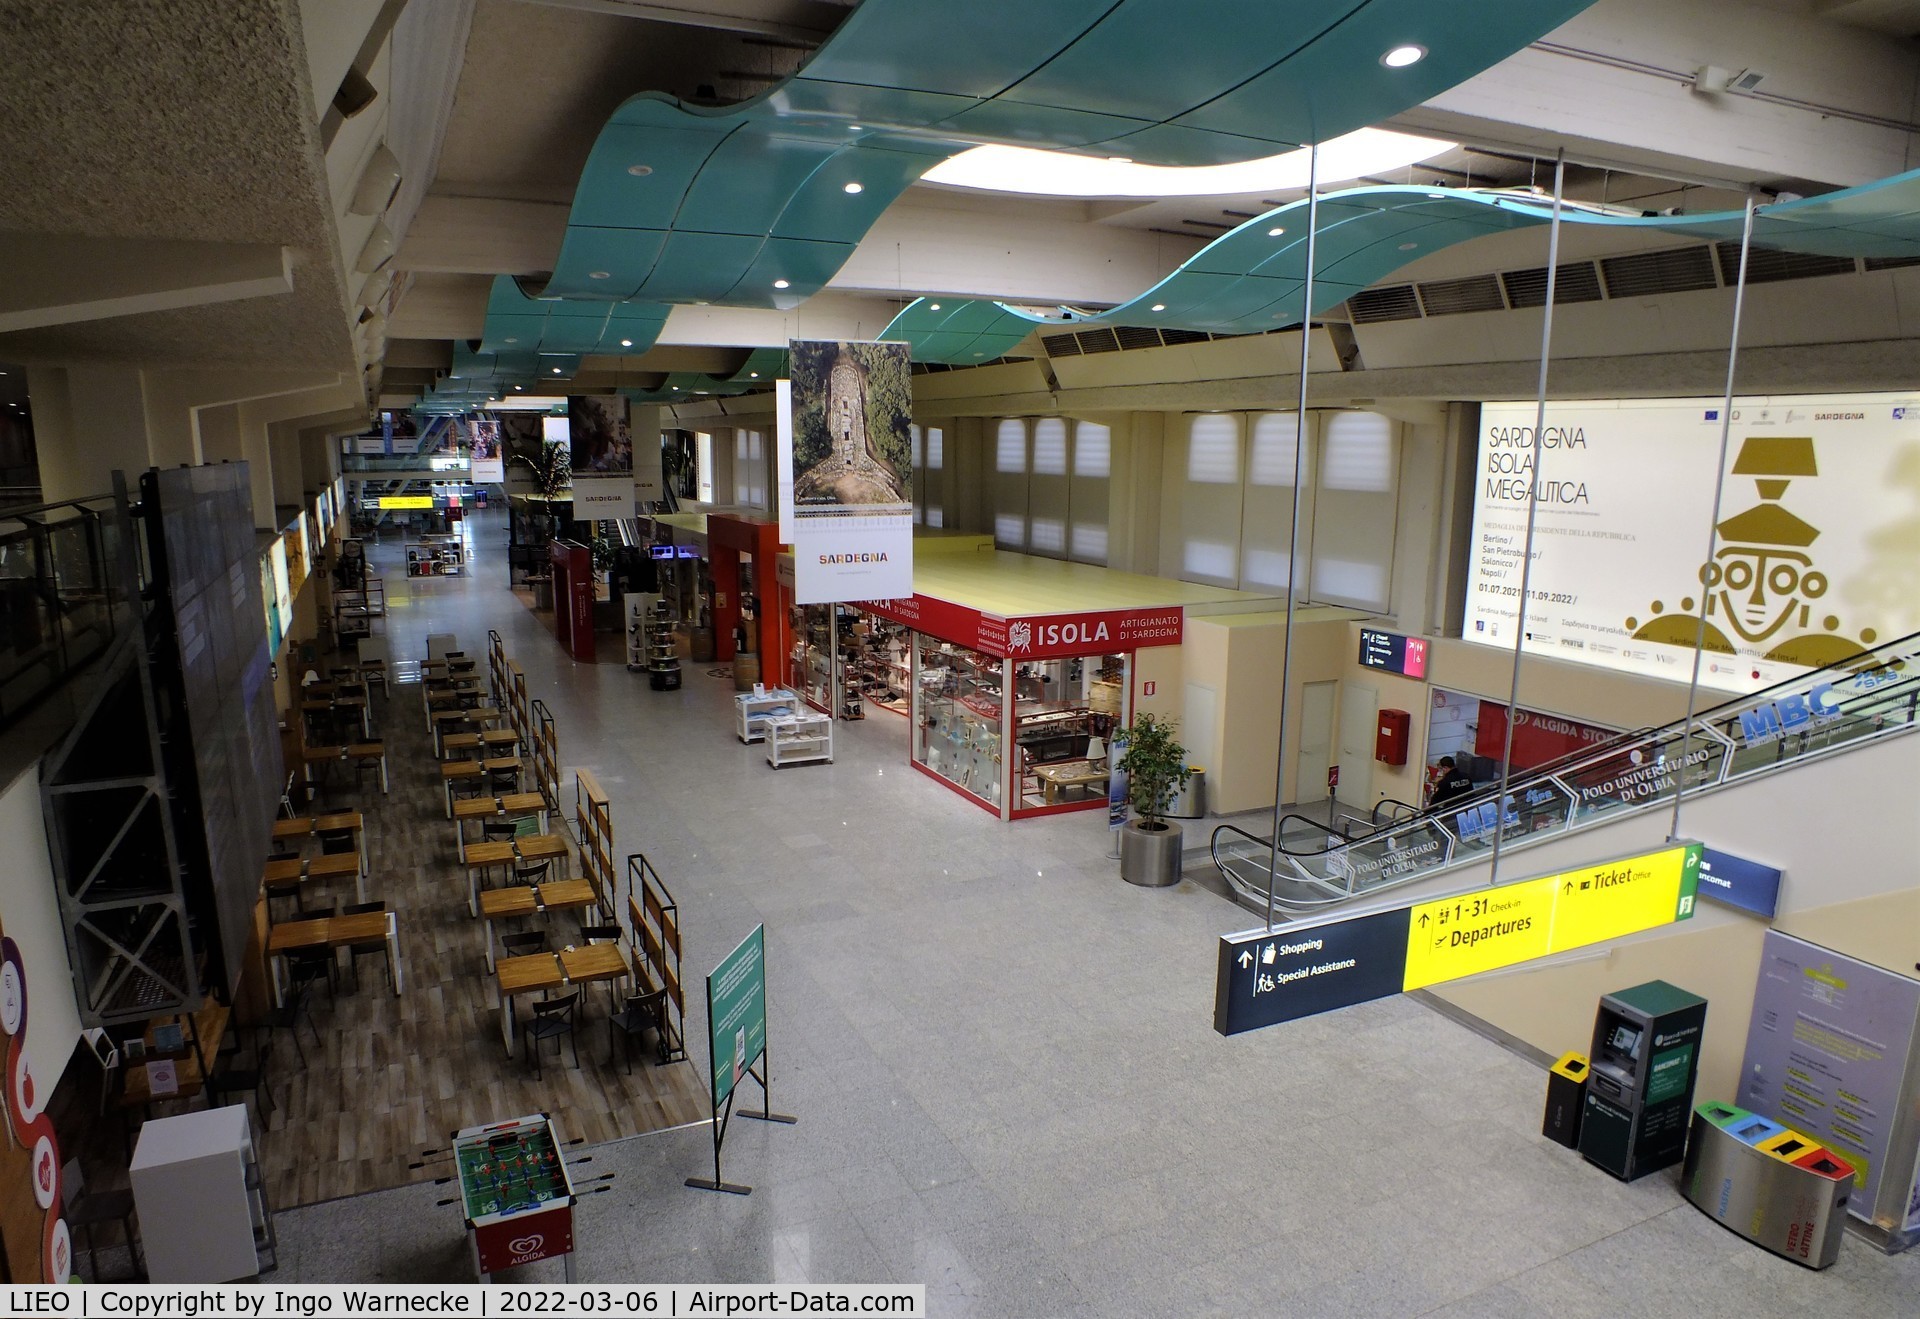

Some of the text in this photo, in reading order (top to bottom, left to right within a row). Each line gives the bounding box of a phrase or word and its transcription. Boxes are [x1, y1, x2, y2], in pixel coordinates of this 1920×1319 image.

[1814, 412, 1865, 421] SARDEGNA
[1487, 452, 1534, 475] ISOLA
[1483, 533, 1508, 545] Berlino
[1532, 526, 1568, 536] RESIDENTE
[1568, 528, 1591, 538] DELLA
[1591, 530, 1637, 543] REPUBBLICA
[819, 552, 889, 565] SARDEGNA
[1481, 556, 1513, 569] Salonicco
[1482, 545, 1496, 554] San
[1496, 547, 1537, 561] Pietrobugo
[1480, 567, 1502, 579] Napoli
[1478, 582, 1521, 598] 01.07.2021
[1526, 588, 1573, 605] 11.09.2022
[899, 607, 920, 621] SARDEGNA
[1477, 604, 1500, 616] Sardinia
[1120, 616, 1179, 629] ARTIGIANATO
[1037, 621, 1110, 646] ISOLA
[1120, 627, 1179, 640] DI SARDEGNA
[1720, 643, 1773, 661] Megalithische
[1777, 652, 1798, 664] Insel
[1738, 682, 1841, 748] MBC
[1531, 717, 1578, 739] ALGIDA
[1582, 781, 1614, 801] POLO
[1620, 775, 1676, 802] DI OLBIA
[1356, 860, 1378, 875] POLO
[1378, 840, 1439, 868] UNIVERSITARIO
[1381, 859, 1418, 878] DI OLBIA
[1594, 867, 1652, 891] Ticket Office
[1490, 899, 1521, 914] Check-in
[1450, 914, 1532, 948] Departures
[1279, 937, 1323, 957] Shopping
[1277, 956, 1356, 984] Special Assistance
[1786, 1222, 1800, 1253] VETRO
[1799, 1221, 1815, 1259] LATTINE
[510, 1251, 546, 1265] ALGIDA
